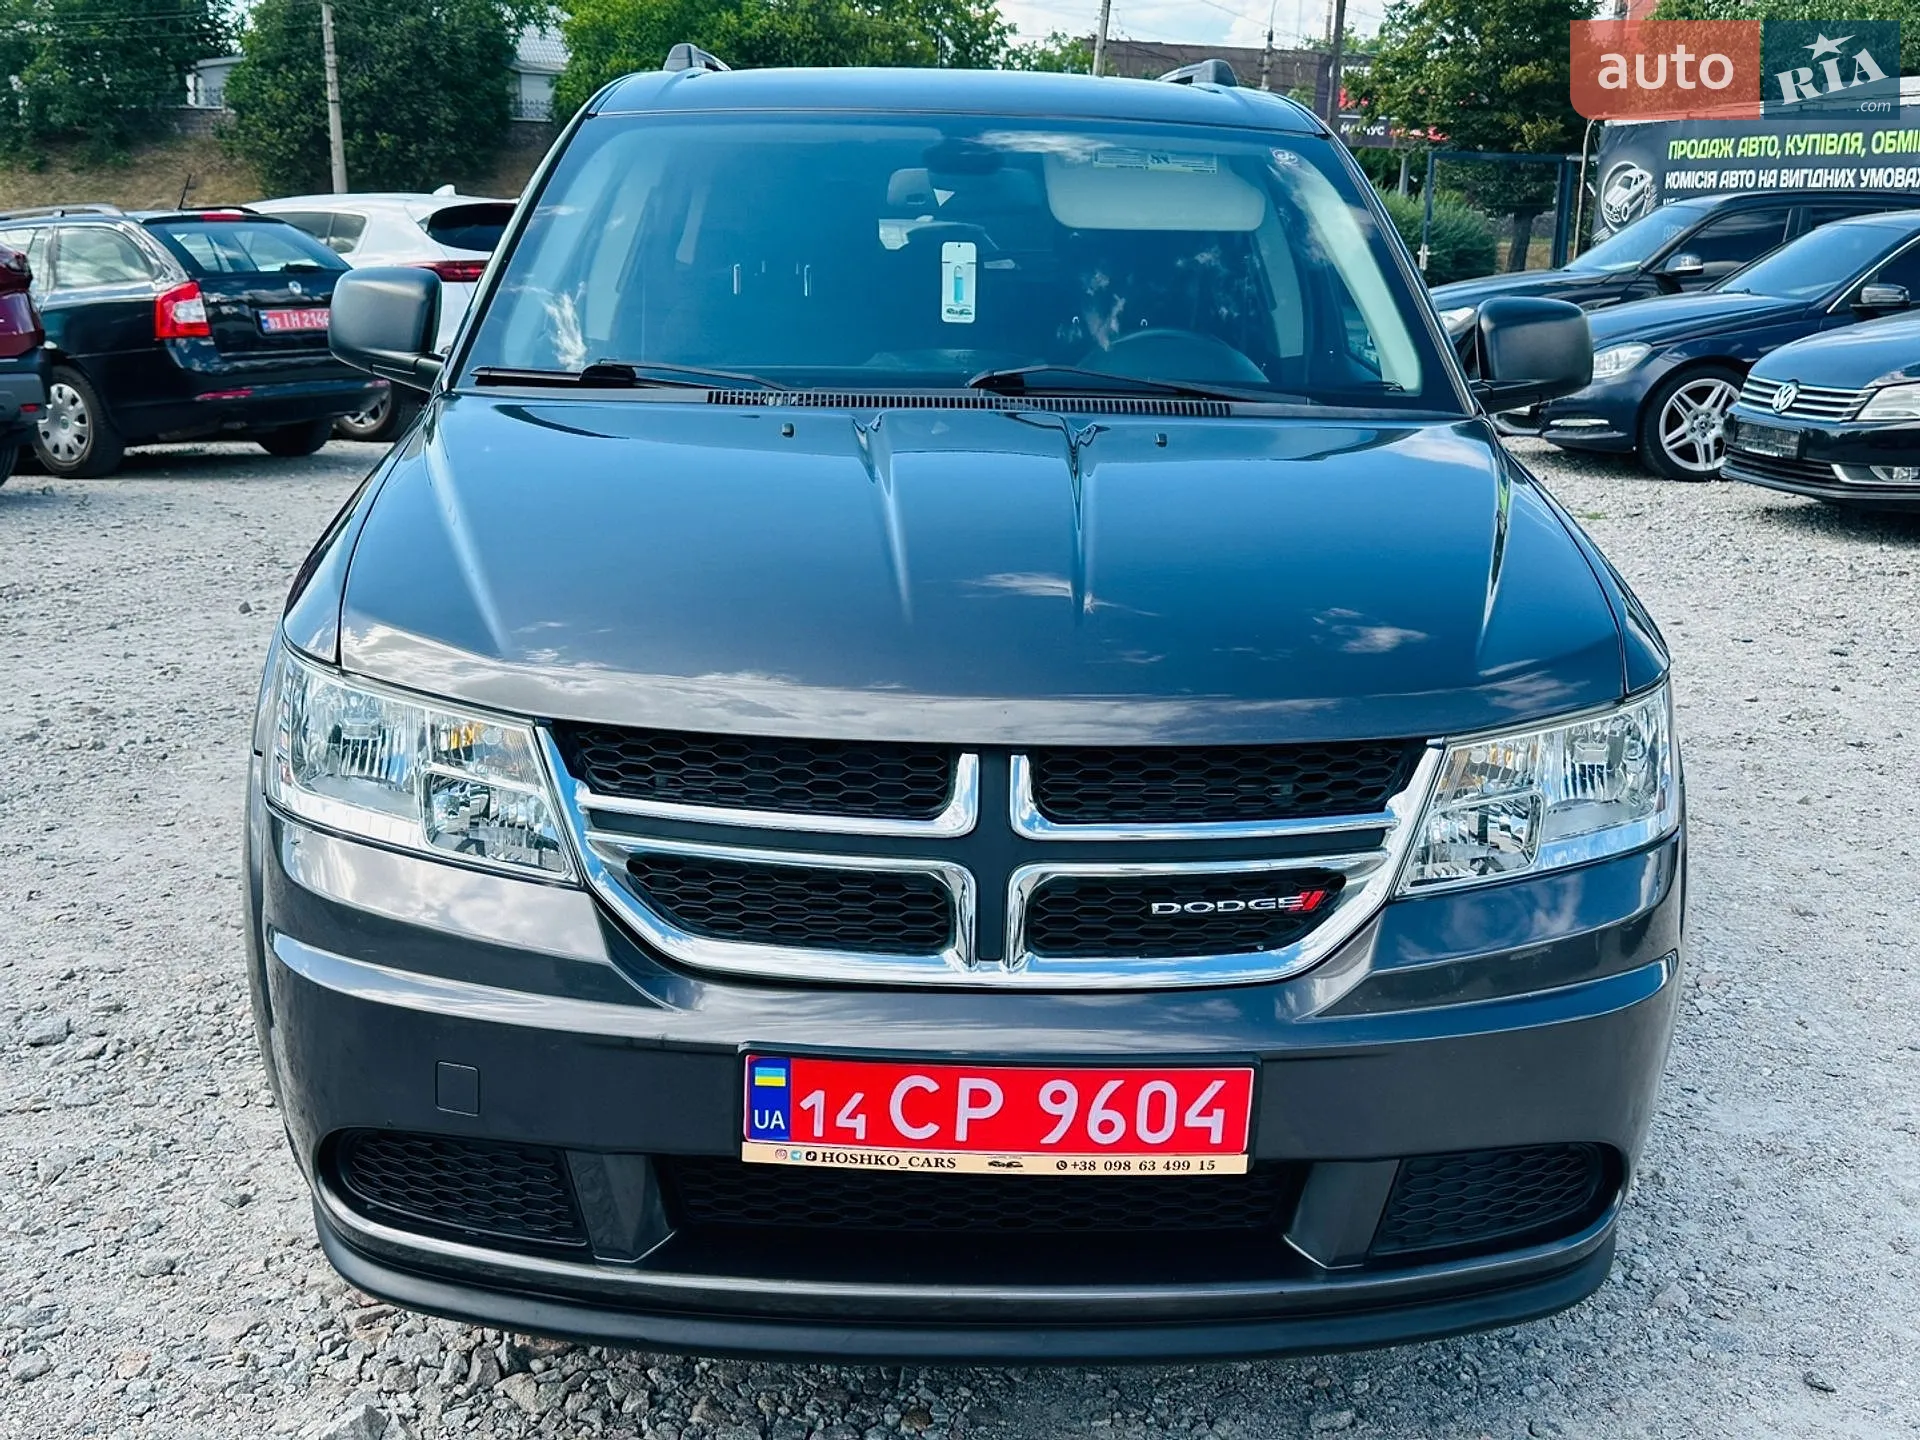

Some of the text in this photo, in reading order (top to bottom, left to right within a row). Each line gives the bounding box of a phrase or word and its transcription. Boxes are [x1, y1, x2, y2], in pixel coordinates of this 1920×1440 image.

[1668, 129, 1920, 160] ПРОДАЖ АВТО, КУПІВЛЯ, ОБМІ
[1665, 170, 1718, 189] КОМІСІЯ
[1719, 169, 1756, 188] АВТО
[1758, 168, 1778, 188] НА
[1779, 167, 1857, 188] ВИГІДНИХ
[1151, 895, 1304, 915] DODGE
[754, 1109, 786, 1130] UA
[799, 1089, 867, 1140] 14
[1038, 1079, 1226, 1145] 9604
[820, 1151, 1216, 1171] HOSHKO_CARS +38 098 63 499 15
